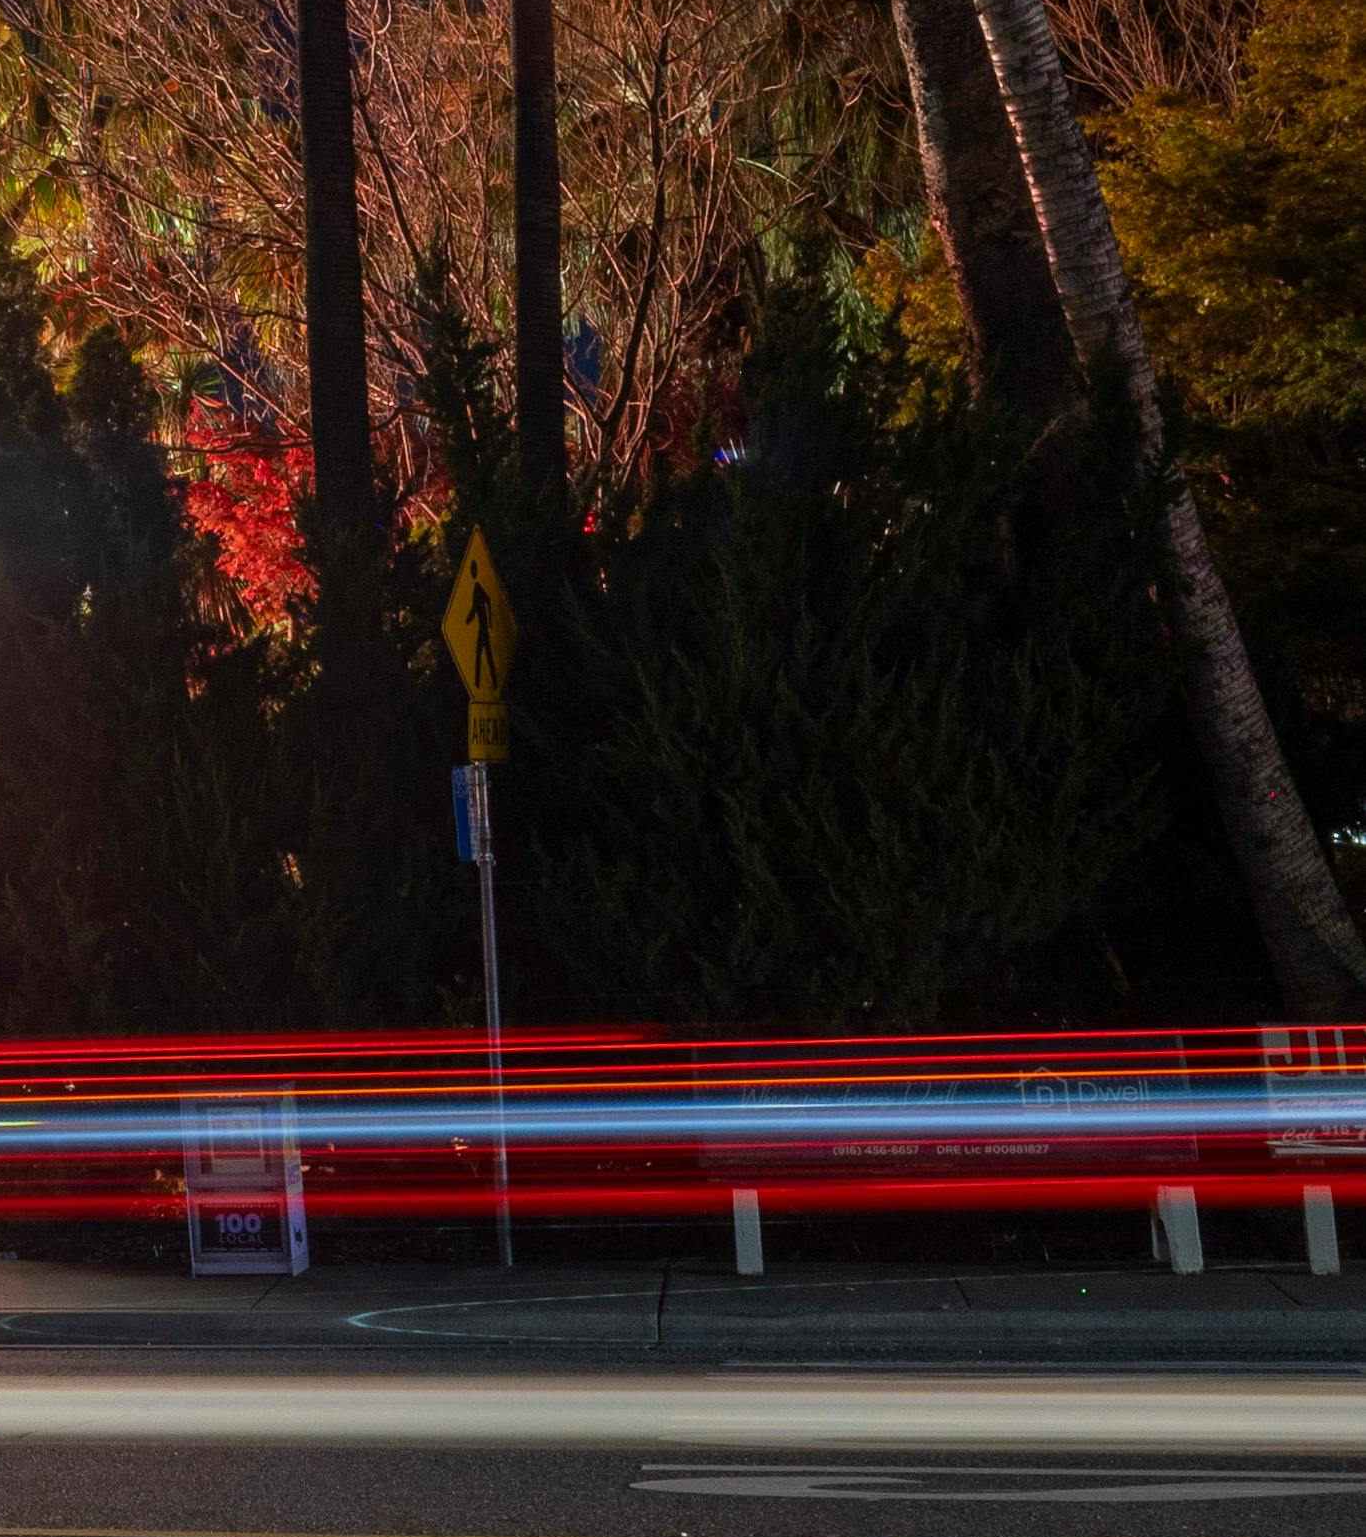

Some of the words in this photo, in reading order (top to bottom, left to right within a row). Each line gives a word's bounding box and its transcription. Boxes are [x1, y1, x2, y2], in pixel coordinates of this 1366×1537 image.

[473, 718, 507, 745] AHEAD
[1078, 1080, 1150, 1102] Dwell
[1321, 1124, 1349, 1135] 916
[833, 1145, 862, 1156] (916)
[936, 1144, 961, 1155] DRE
[964, 1144, 981, 1155] Lic
[219, 1233, 264, 1244] LOCAL
